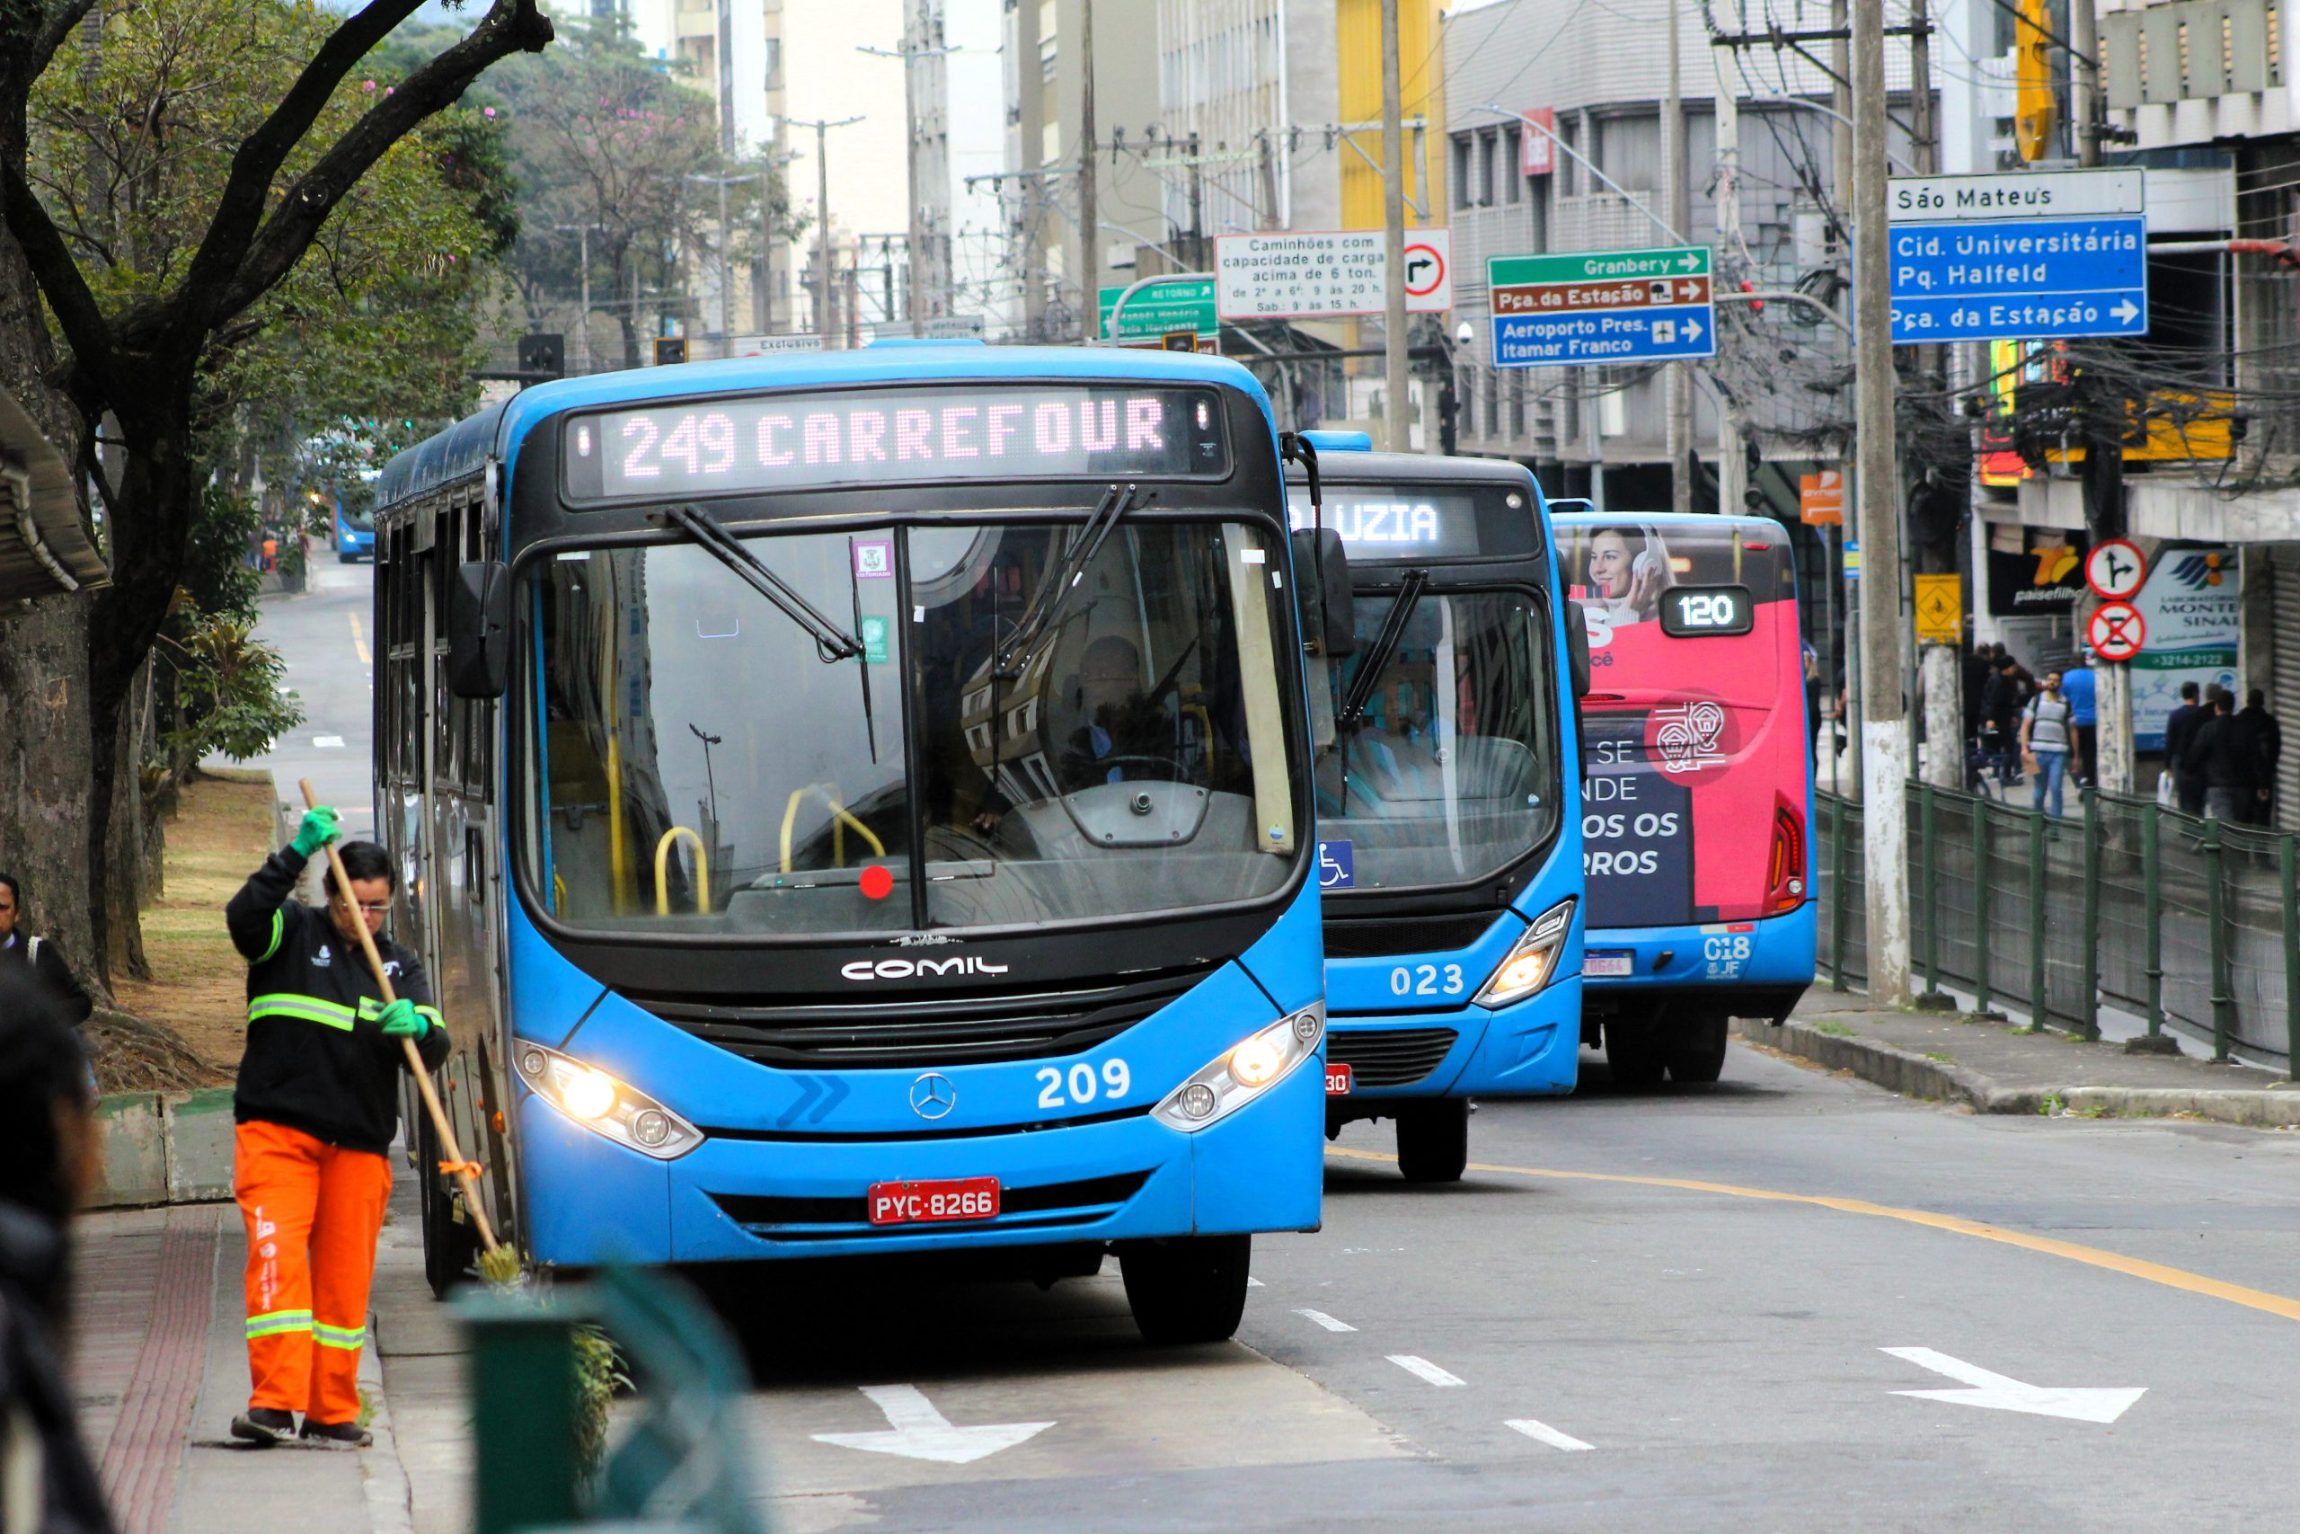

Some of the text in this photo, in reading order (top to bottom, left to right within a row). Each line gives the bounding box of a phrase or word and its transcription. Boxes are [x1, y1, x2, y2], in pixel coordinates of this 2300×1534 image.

[1898, 187, 2051, 210] São Mateus
[1250, 237, 1374, 251] Caminhões com
[1898, 227, 2136, 256] Cid. Universitária
[1223, 253, 1385, 268] capacidade de carga
[1584, 257, 1671, 276] Granbery
[1253, 267, 1376, 282] acima de 6 ton.
[1898, 263, 2047, 290] Pq. Halfeld
[1152, 288, 1197, 299] RETORNO
[1233, 288, 1246, 298] de
[1275, 288, 1282, 296] a
[1314, 286, 1320, 295] 9
[1330, 284, 1343, 295] às
[1352, 284, 1365, 294] 20
[1372, 283, 1382, 293] h.
[1499, 284, 1644, 309] Pça. da Estação
[1293, 301, 1299, 311] 9
[1308, 299, 1322, 311] às
[1331, 300, 1342, 309] 15
[1350, 299, 1360, 308] h.
[1950, 308, 1980, 327] da
[1989, 301, 2098, 327] Estação
[1503, 317, 1648, 339] Aeroporto Pres.
[760, 339, 821, 350] Exclusivo
[1503, 339, 1632, 358] Itamar Franco
[622, 398, 1162, 477] 249 CARREFOUR
[1679, 595, 1734, 626] 120
[2159, 603, 2239, 613] MONTE
[1634, 812, 1678, 837] OS
[1704, 936, 1750, 961] 018
[841, 956, 1008, 980] COMIL
[1722, 961, 1740, 974] JF
[1391, 964, 1464, 996] 023
[1035, 1058, 1131, 1110] 209
